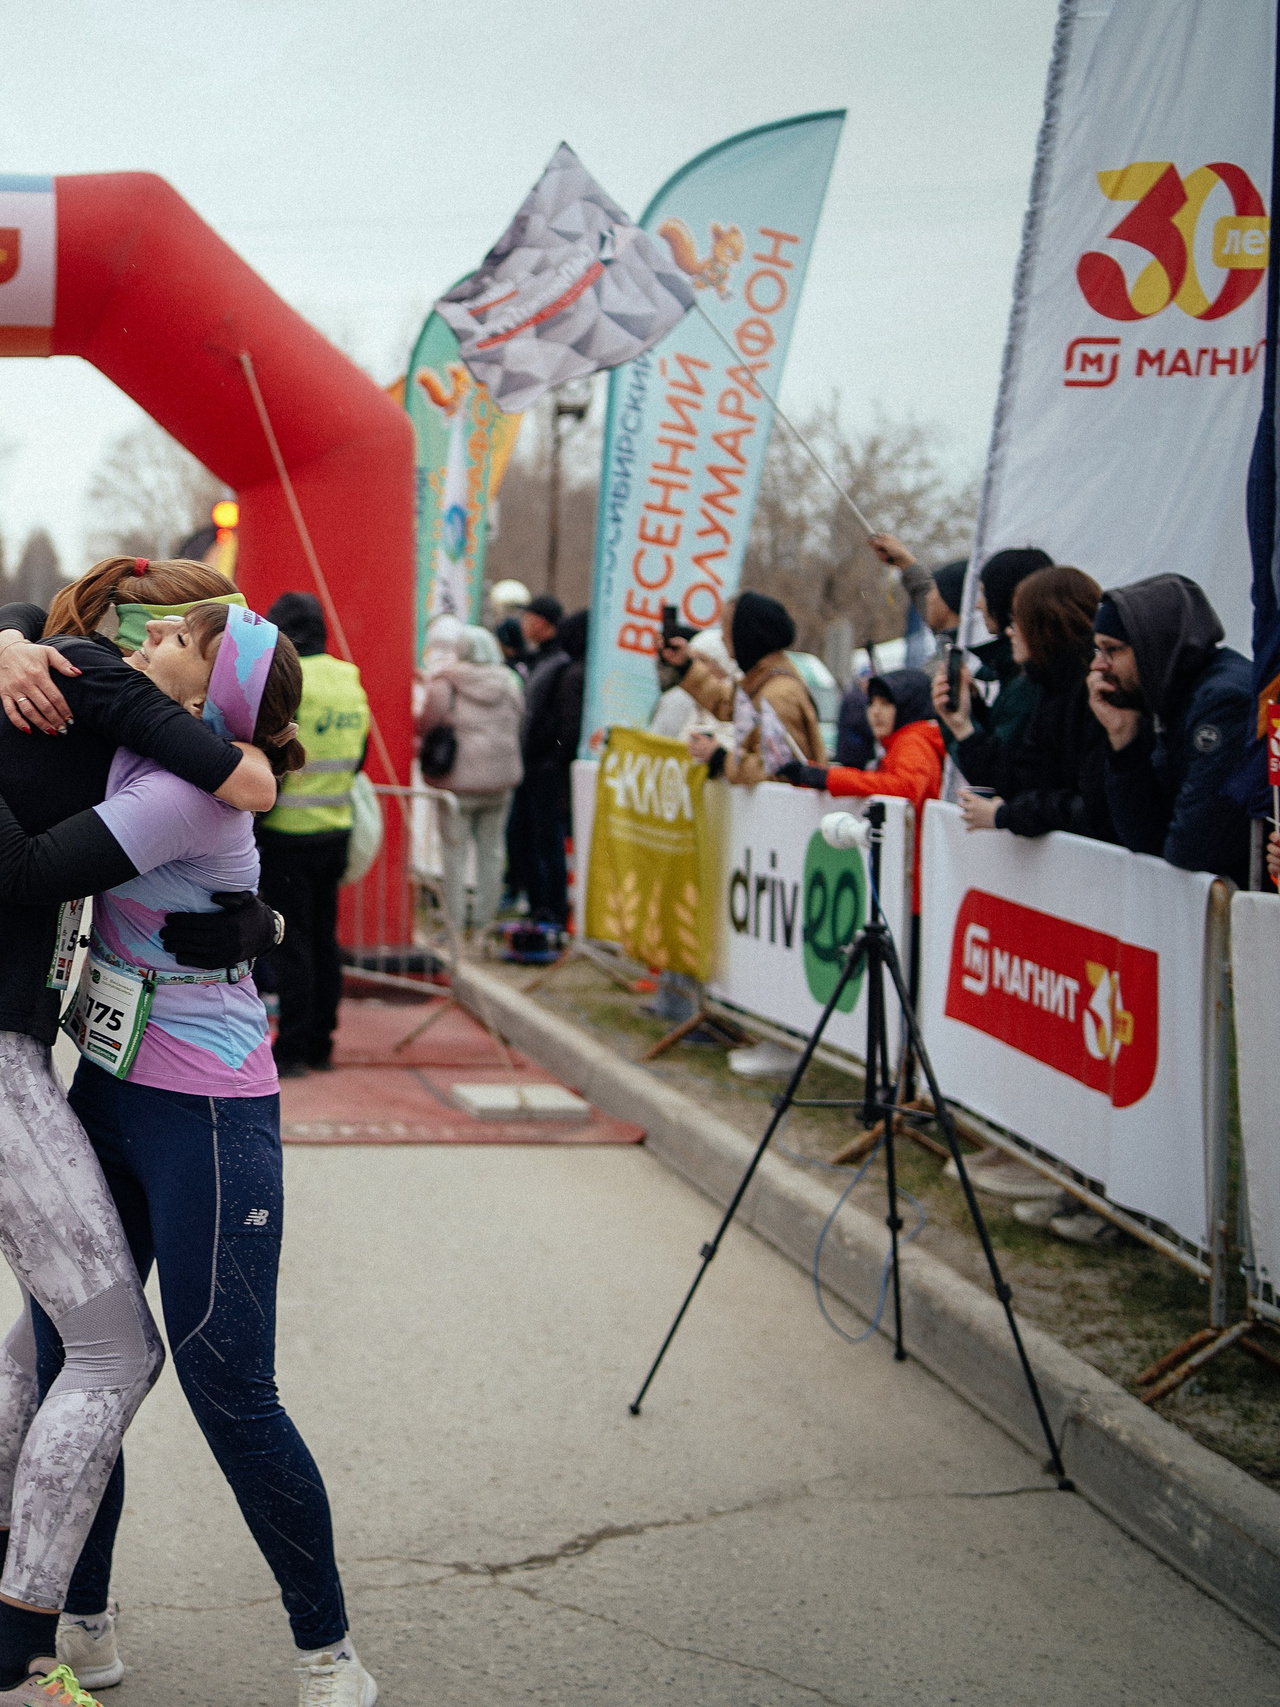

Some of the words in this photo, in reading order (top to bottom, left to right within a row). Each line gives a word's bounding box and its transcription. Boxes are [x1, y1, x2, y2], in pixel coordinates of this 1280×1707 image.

[1076, 161, 1269, 321] 30
[1222, 228, 1269, 255] ле
[1136, 338, 1267, 376] МАГНИ
[681, 226, 802, 628] ОЛУМАРАФОН
[617, 352, 712, 658] ВЕСЕННИЙ
[730, 847, 862, 977] drivee
[992, 947, 1080, 1023] МАГНИТ
